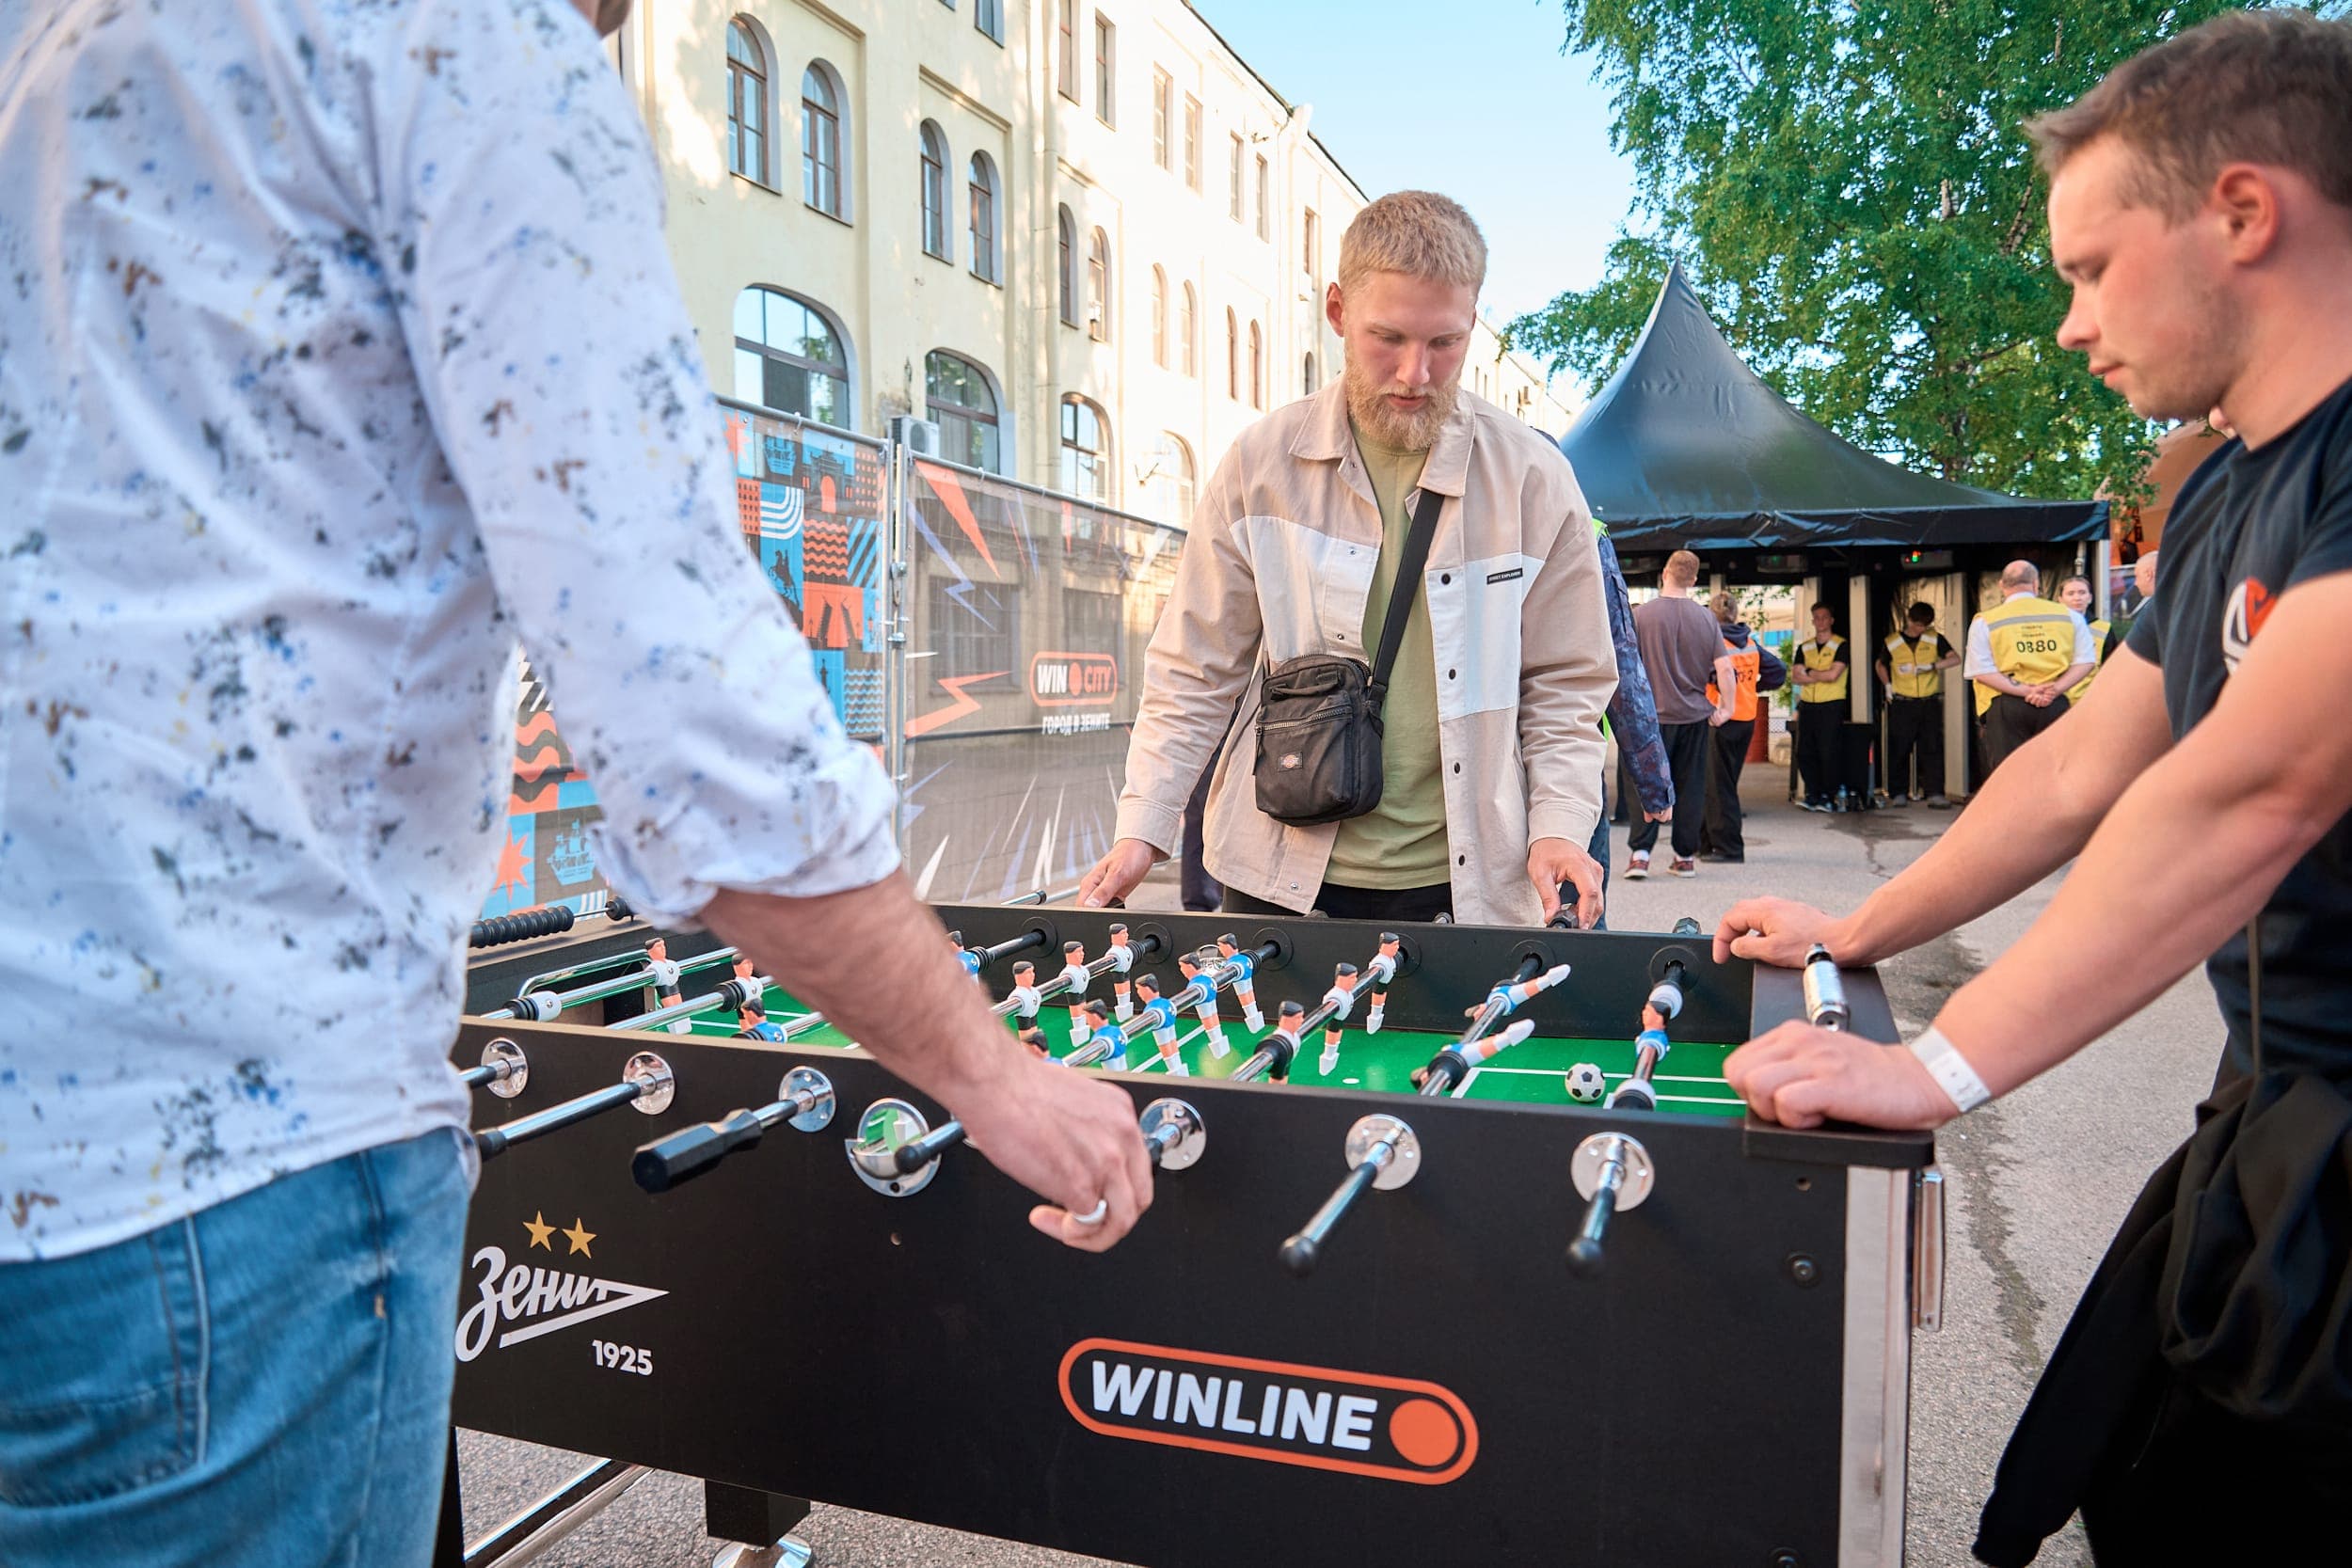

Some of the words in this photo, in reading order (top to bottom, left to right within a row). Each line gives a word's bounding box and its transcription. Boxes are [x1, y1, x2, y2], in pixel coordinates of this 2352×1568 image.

[1037, 664, 1068, 693] WIN
[1084, 665, 1111, 693] CITY
[1041, 715, 1073, 736] ГОРОД
[454, 1245, 669, 1362] Зенит
[591, 1339, 654, 1376] 1925
[1091, 1360, 1378, 1451] WINLINE
